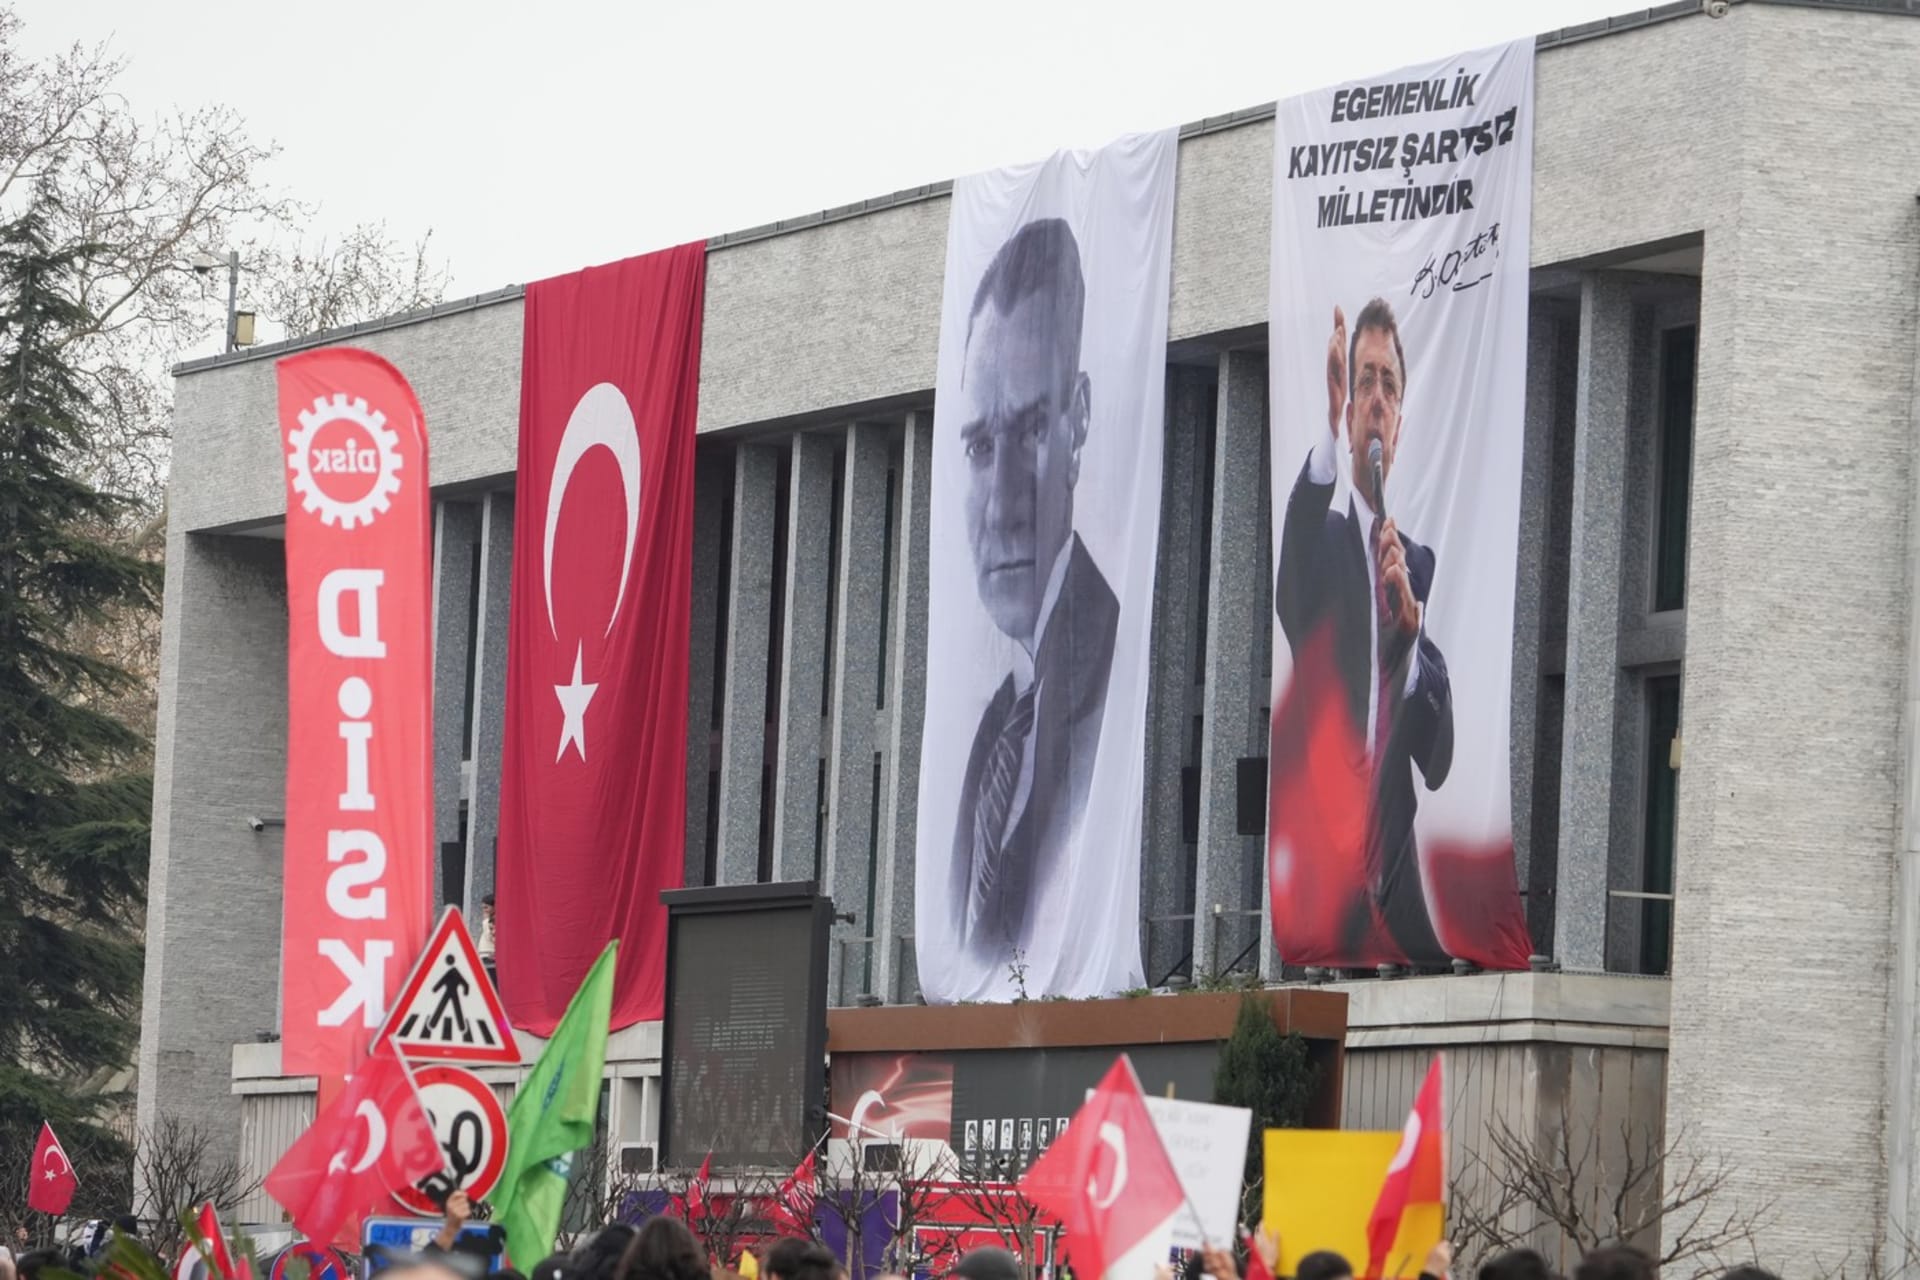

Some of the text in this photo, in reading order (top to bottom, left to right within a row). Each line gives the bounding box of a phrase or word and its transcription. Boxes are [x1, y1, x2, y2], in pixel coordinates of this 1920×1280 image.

[1331, 68, 1480, 123] EGEMENLİK
[1288, 106, 1518, 179] KAYITSIZ ŞARTSIZ
[1317, 174, 1474, 228] MİLLETİNDİR
